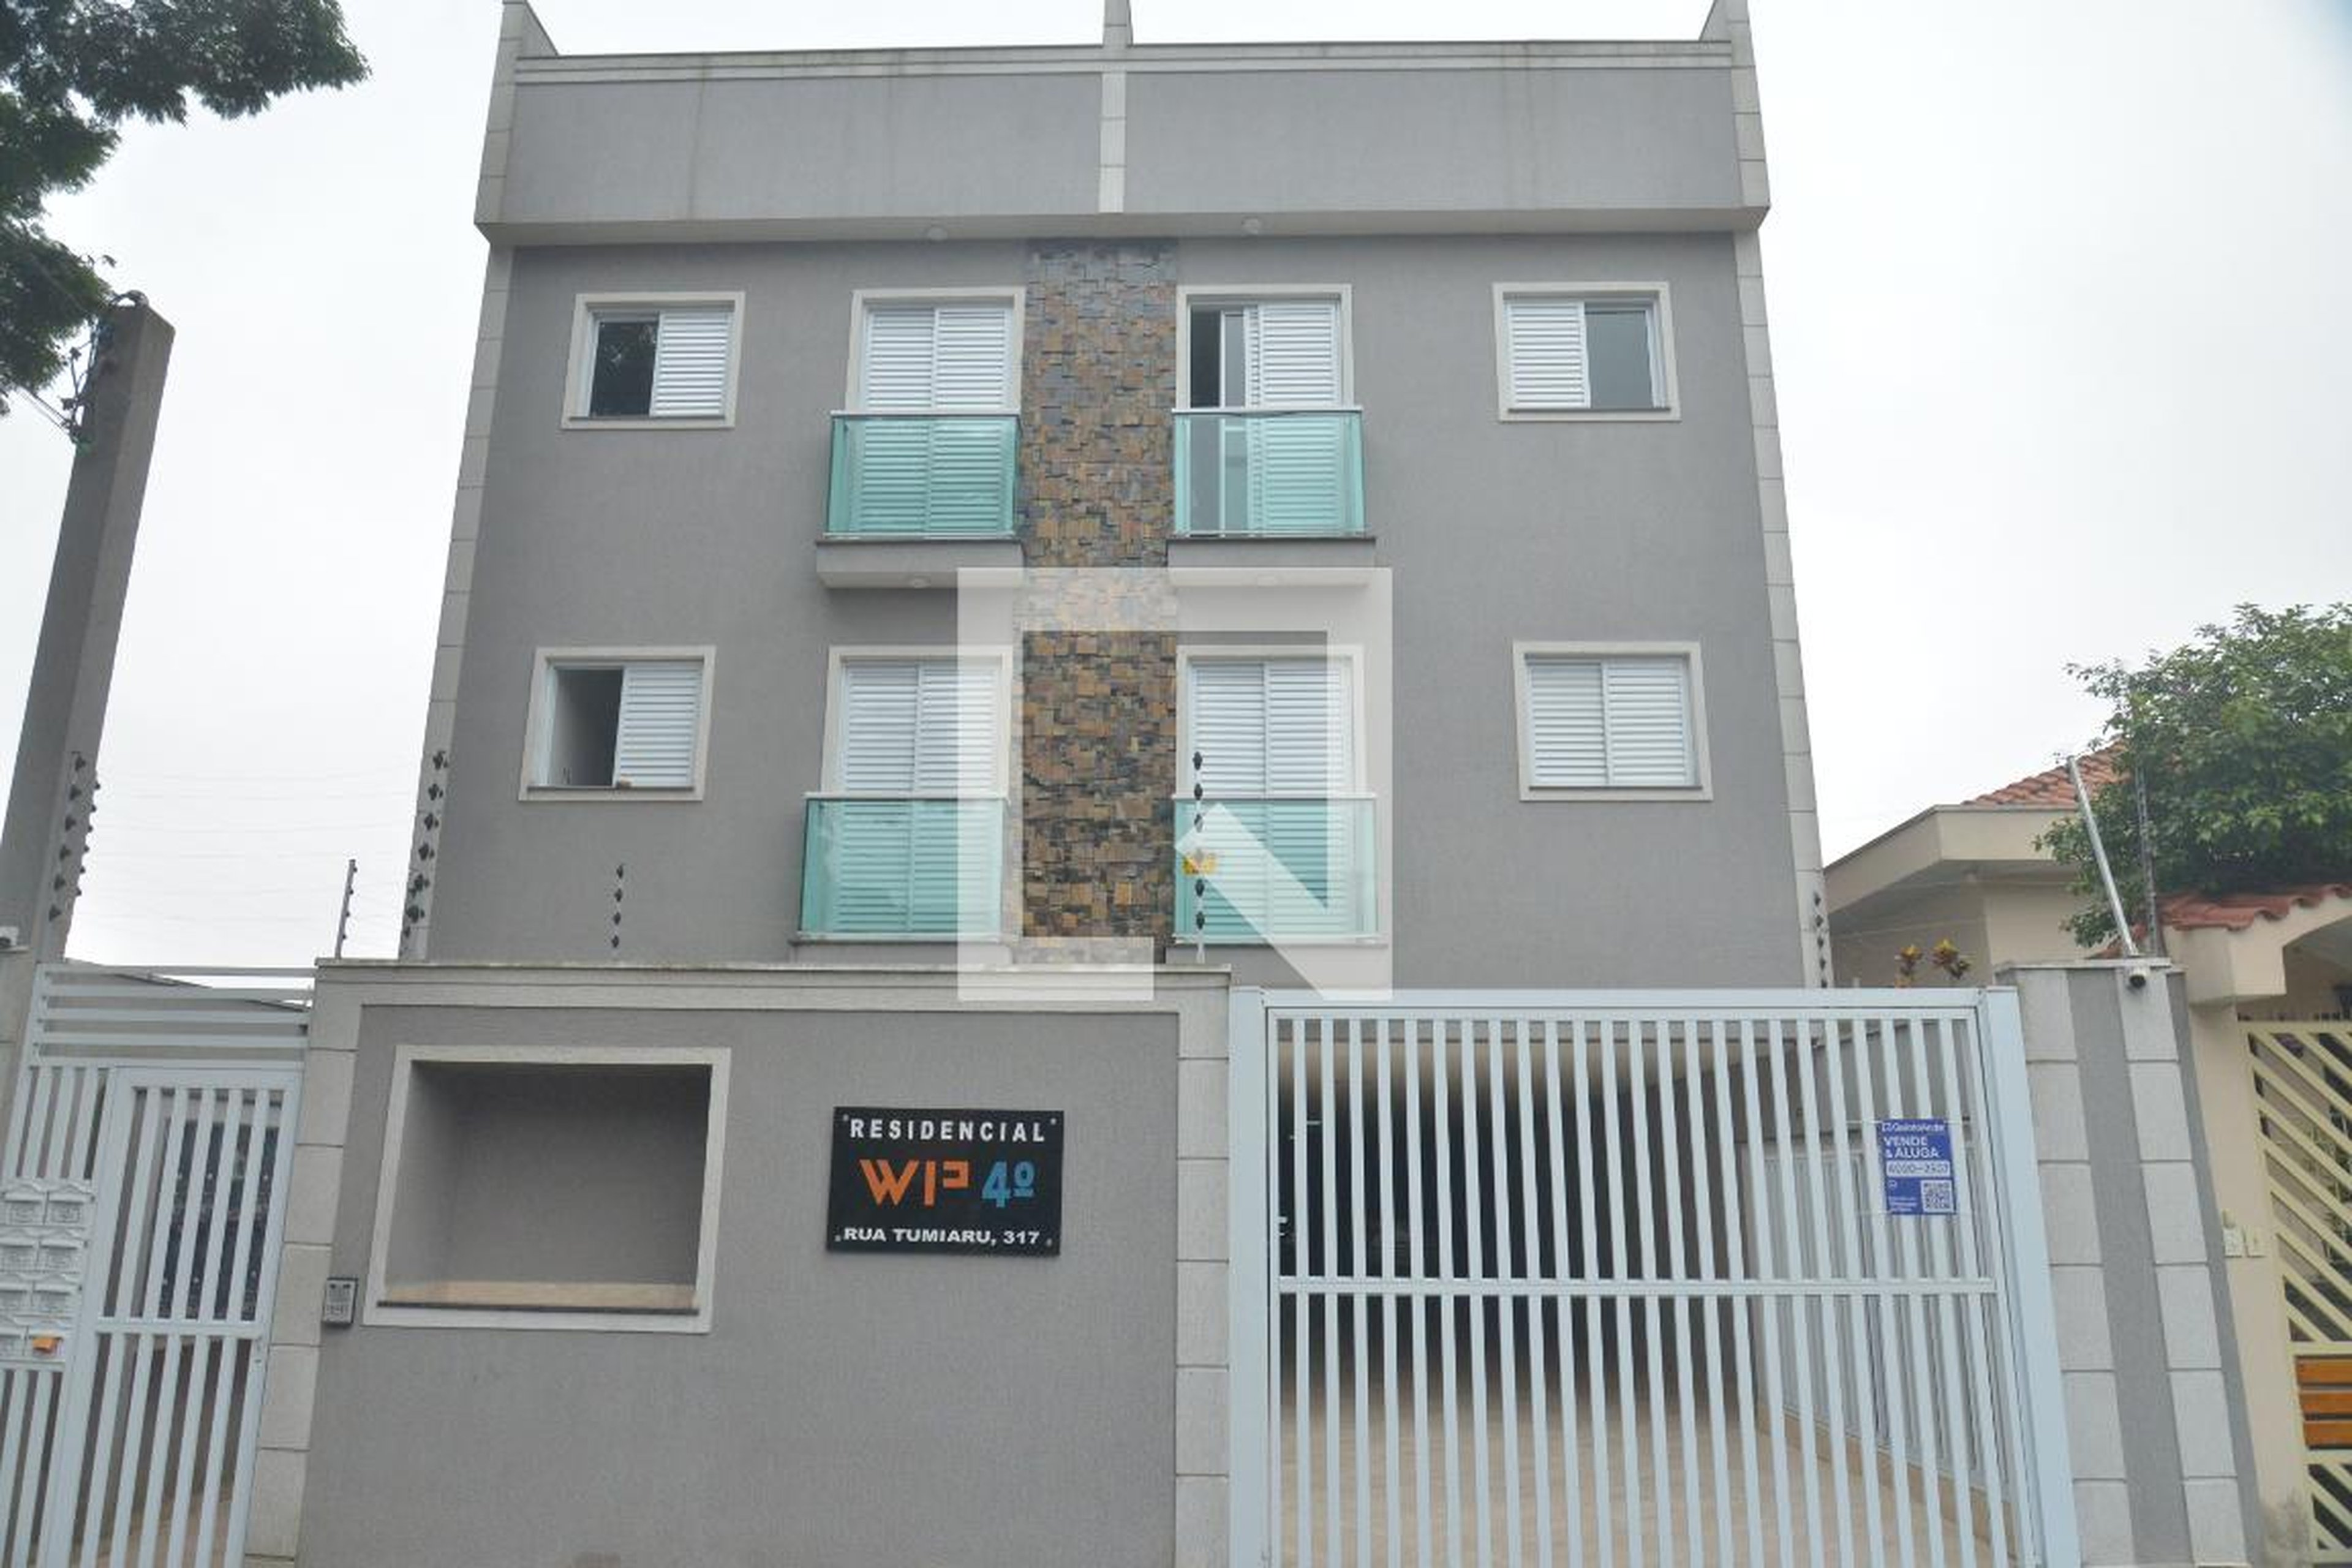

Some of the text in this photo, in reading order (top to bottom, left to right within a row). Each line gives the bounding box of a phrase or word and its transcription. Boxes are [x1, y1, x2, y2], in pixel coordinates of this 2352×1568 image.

[850, 1118, 1045, 1142] RESIDENCIAL
[1883, 1136, 1928, 1147] VENDE
[1894, 1147, 1940, 1159] ALUGA
[843, 1227, 1041, 1247] RUA TUMIARU, 317
